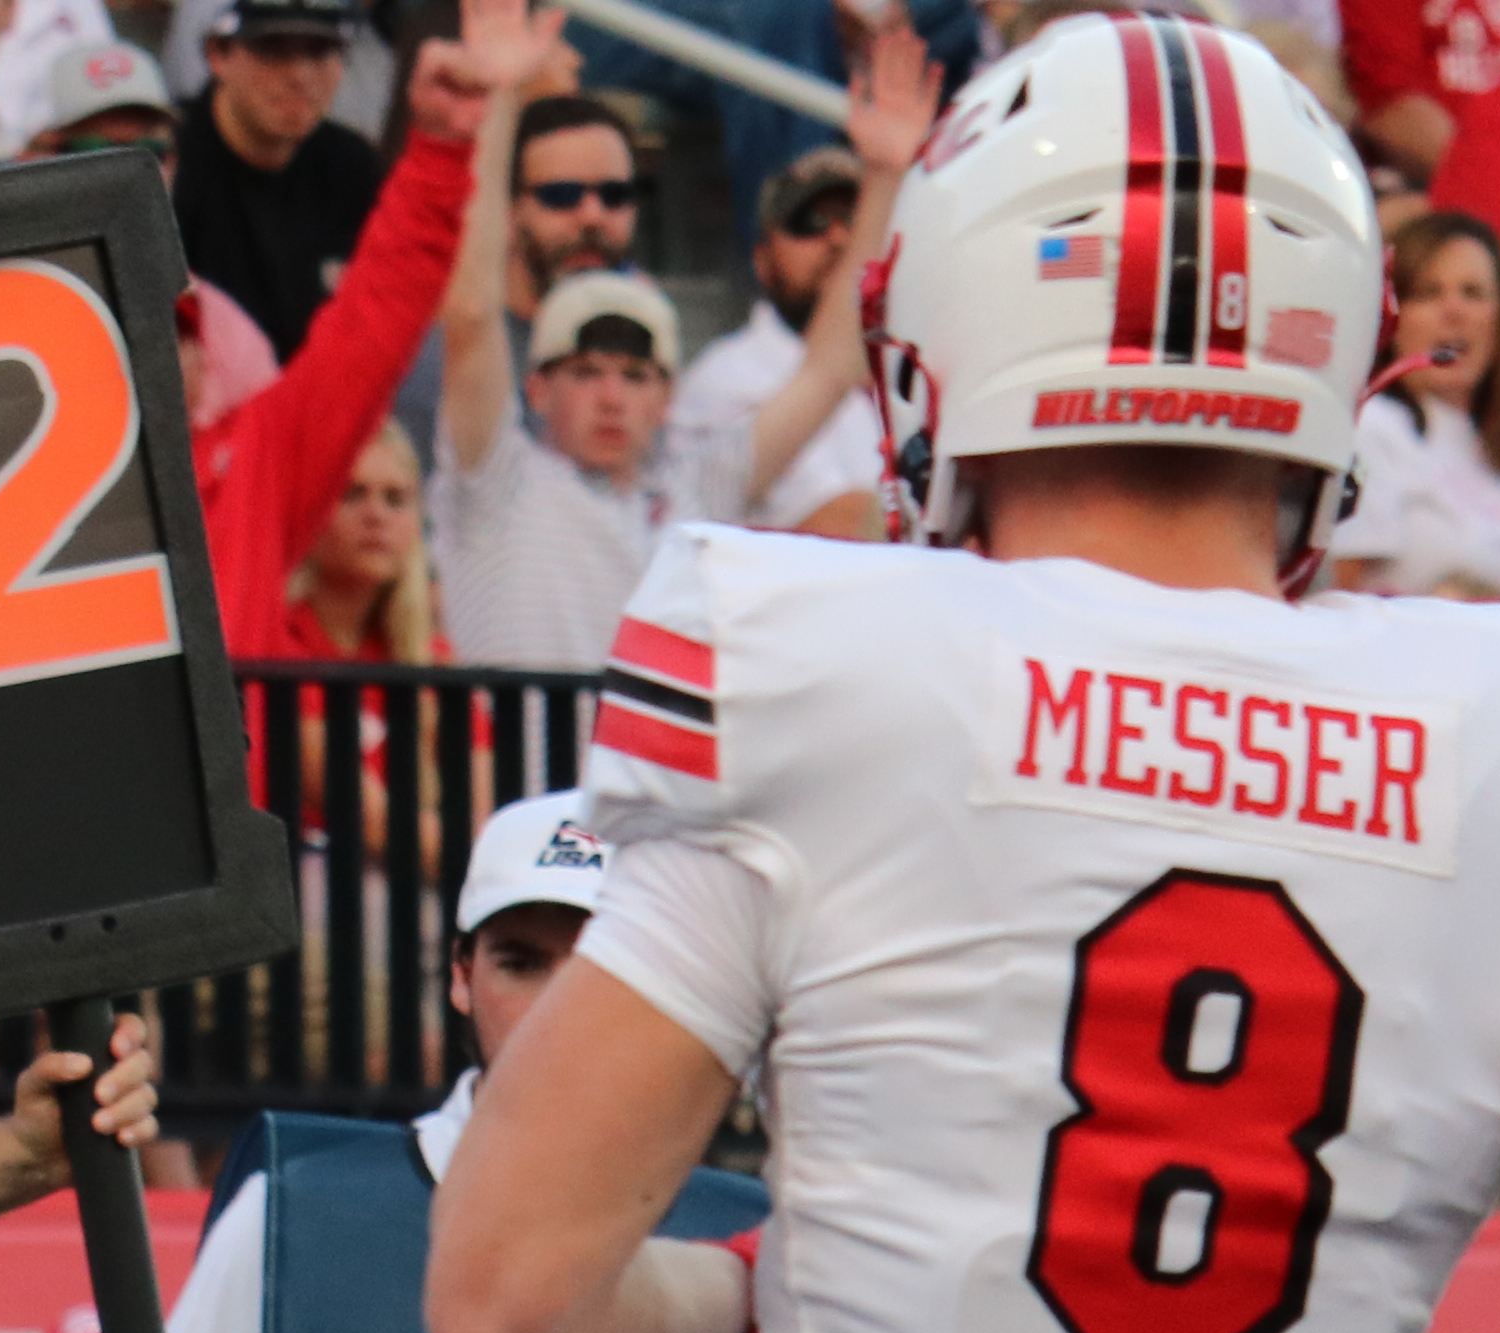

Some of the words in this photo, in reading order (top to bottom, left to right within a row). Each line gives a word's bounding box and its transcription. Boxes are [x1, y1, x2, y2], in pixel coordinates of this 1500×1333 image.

[1214, 272, 1247, 331] 8
[1032, 389, 1303, 435] HILLTOPPERS
[1014, 657, 1428, 844] MESSER
